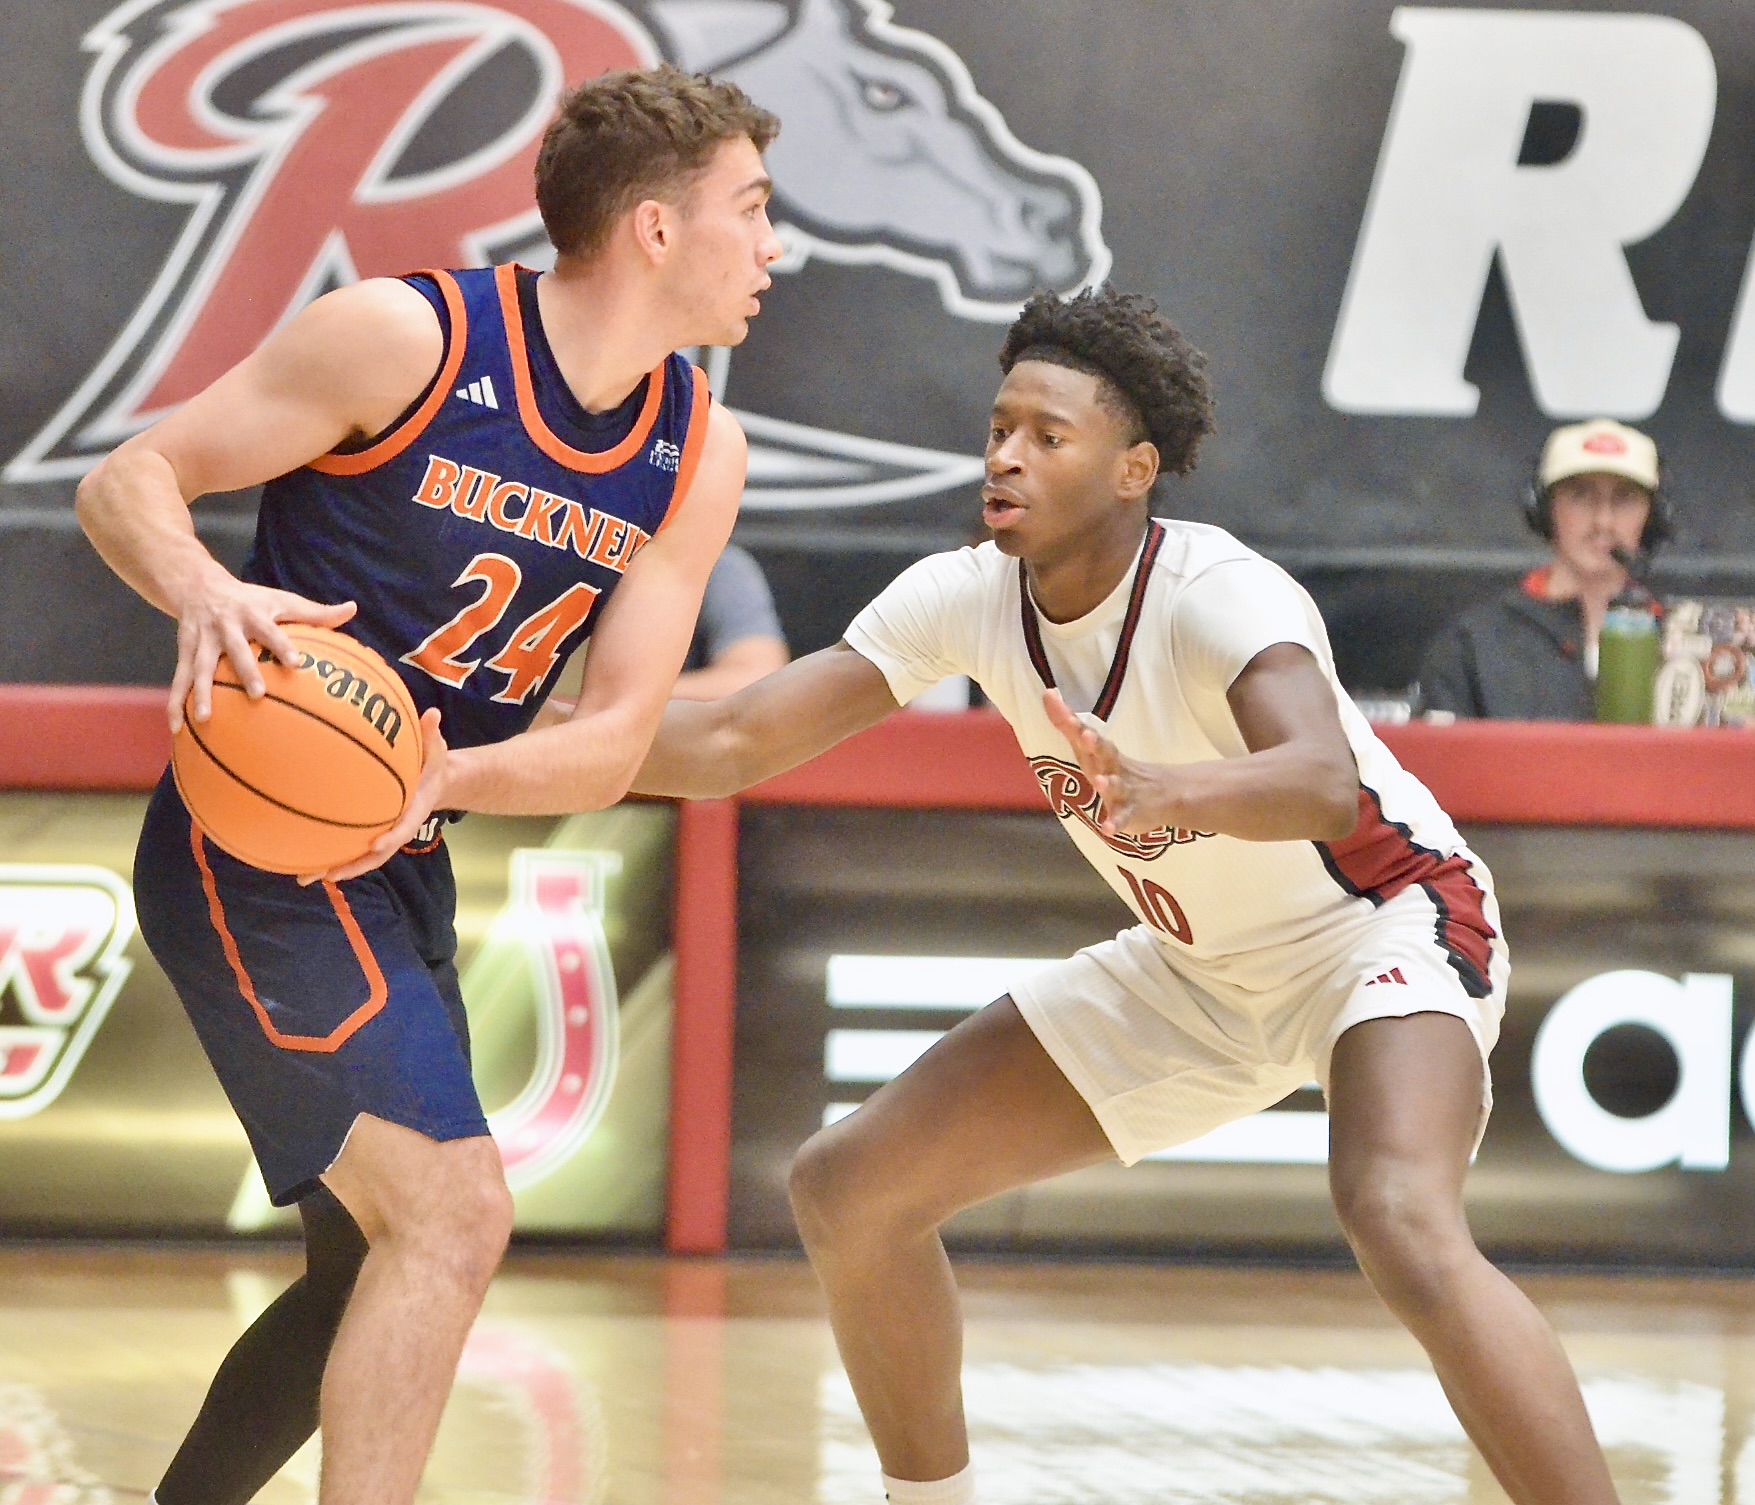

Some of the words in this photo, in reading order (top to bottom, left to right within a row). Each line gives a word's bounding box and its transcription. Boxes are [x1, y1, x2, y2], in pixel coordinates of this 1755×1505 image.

[1322, 5, 1755, 425] R
[399, 552, 602, 706] 24
[1116, 864, 1194, 945] 10
[1530, 968, 1755, 1173] a
